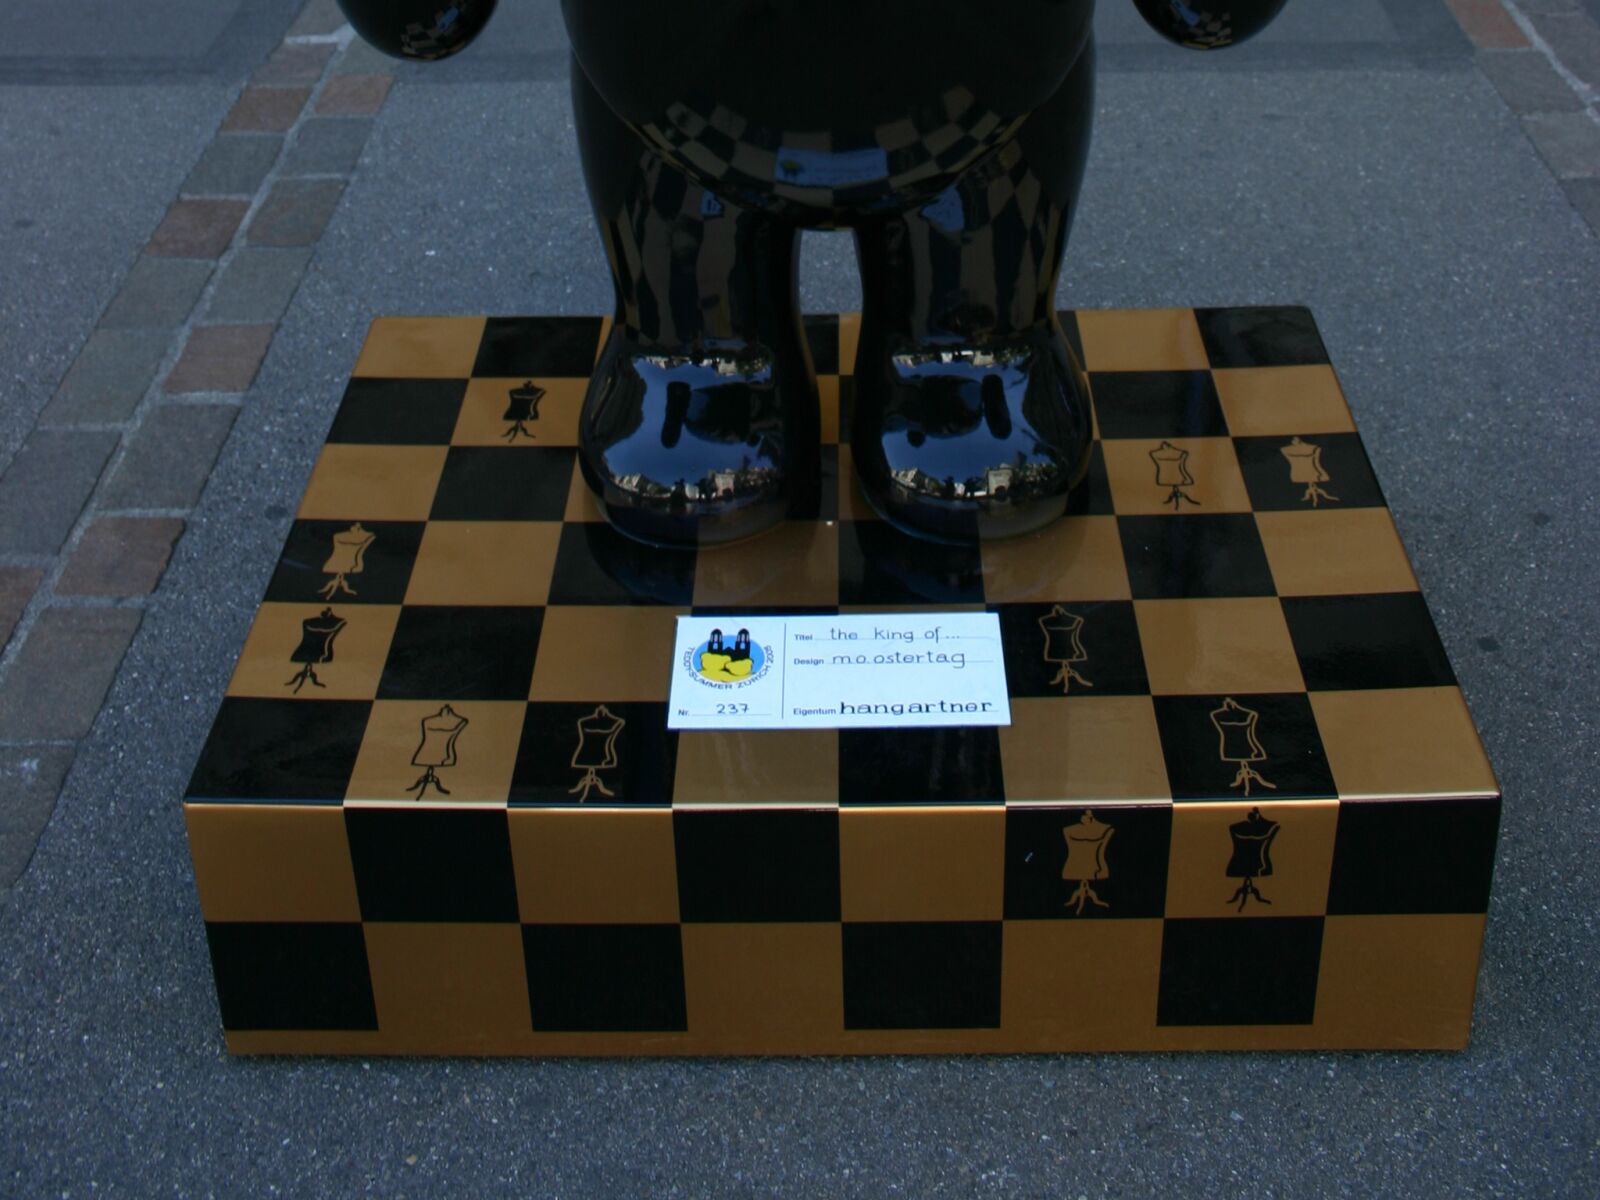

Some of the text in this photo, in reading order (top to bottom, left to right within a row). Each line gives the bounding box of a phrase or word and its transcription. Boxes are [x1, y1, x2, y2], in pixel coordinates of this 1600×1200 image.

[793, 633, 813, 641] Titel
[830, 627, 858, 641] the
[874, 627, 914, 644] king
[793, 657, 825, 666] Design
[716, 702, 750, 715] 237
[793, 700, 993, 717] Eigentum hangartner
